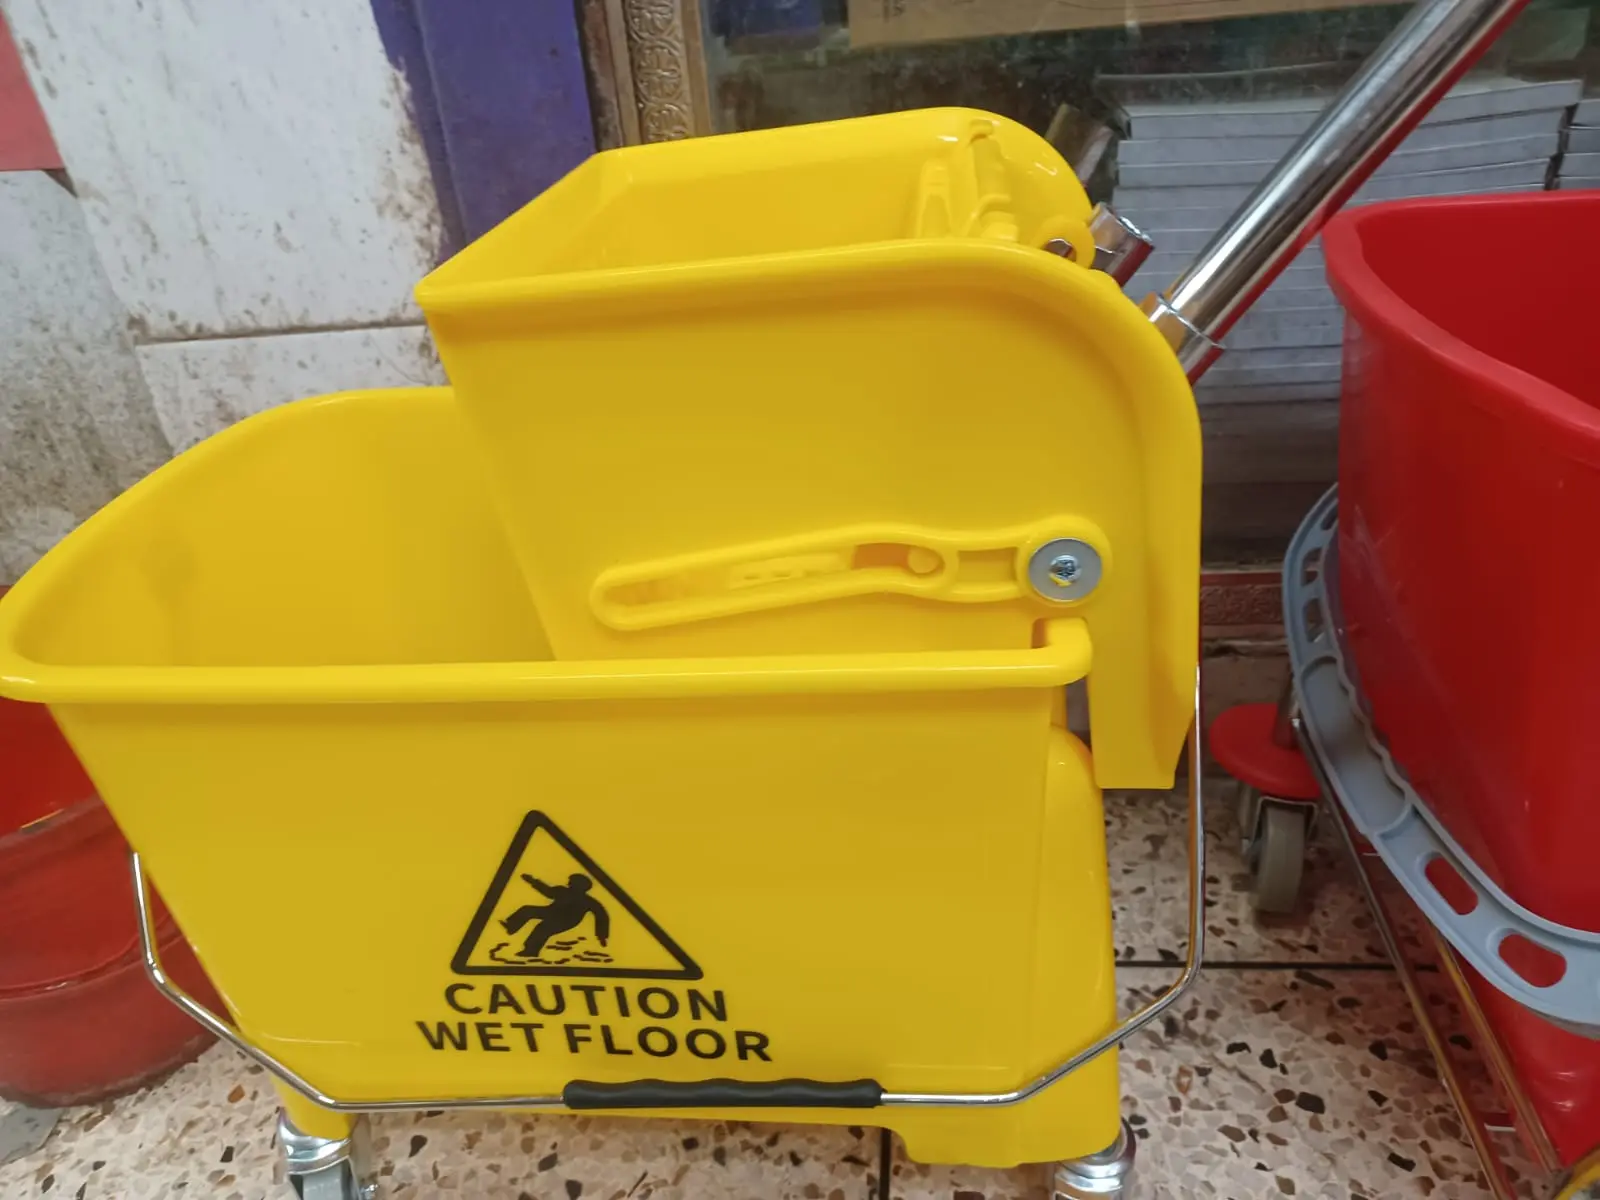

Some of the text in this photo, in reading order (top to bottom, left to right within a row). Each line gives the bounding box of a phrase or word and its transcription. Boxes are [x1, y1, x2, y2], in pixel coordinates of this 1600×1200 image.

[444, 983, 728, 1022] CAUTION
[416, 1021, 773, 1062] WET FLOOR
